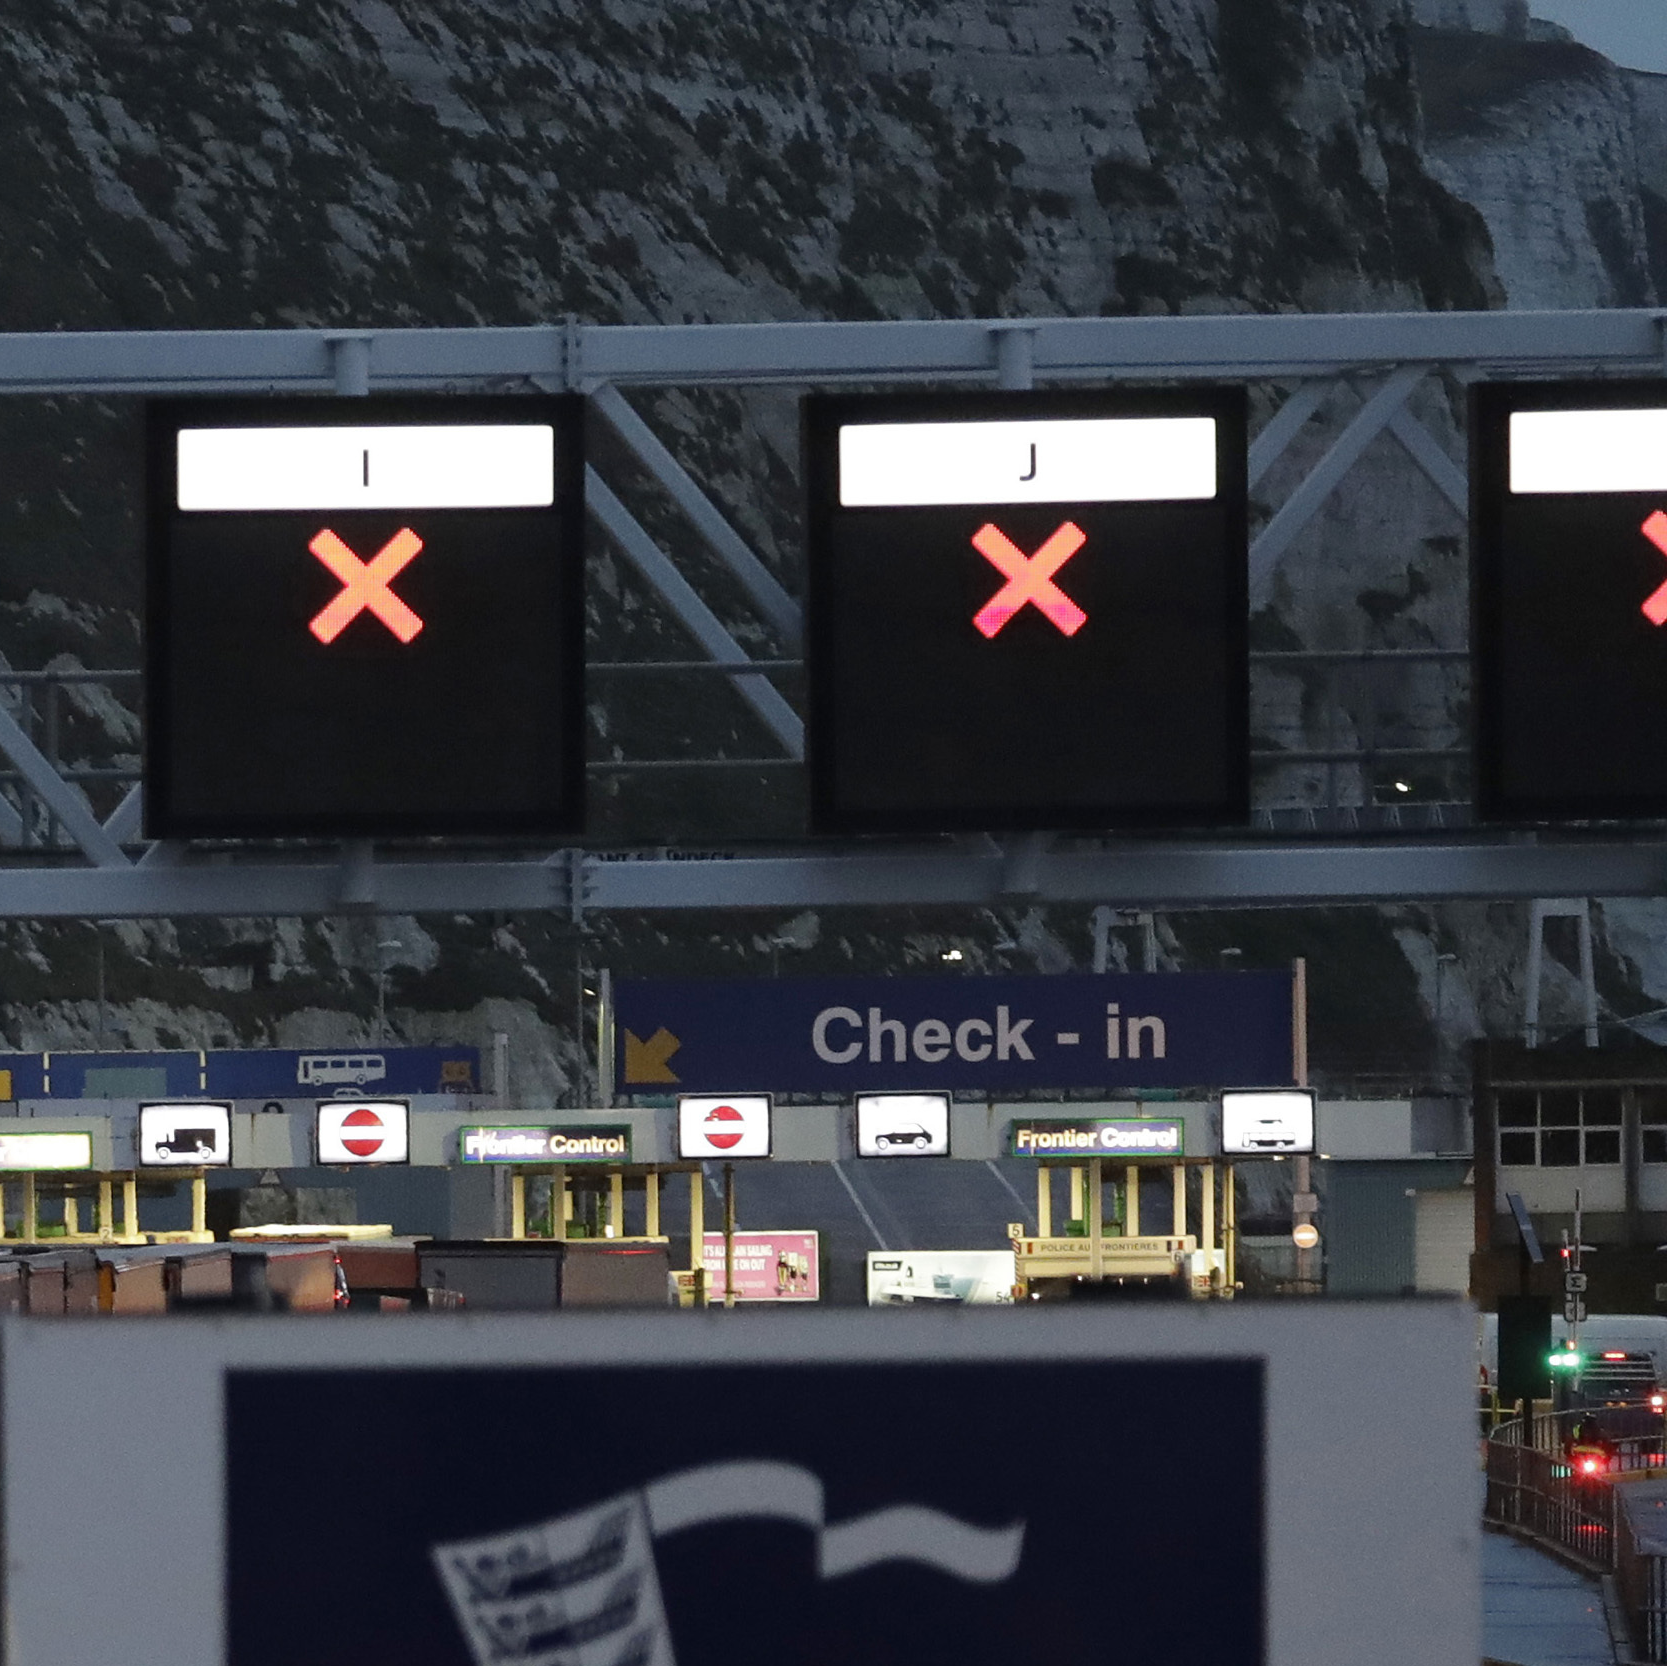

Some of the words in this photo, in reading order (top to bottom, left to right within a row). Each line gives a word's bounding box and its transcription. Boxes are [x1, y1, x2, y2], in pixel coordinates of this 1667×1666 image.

[362, 449, 371, 488] I
[1018, 444, 1038, 482] J
[811, 1005, 1036, 1064] Check
[1105, 1002, 1167, 1060] in
[466, 1134, 547, 1155] Frontier
[549, 1134, 625, 1154] Control
[1017, 1129, 1098, 1148] Frontier
[1100, 1127, 1178, 1148] Control
[1040, 1243, 1075, 1252] POLICE
